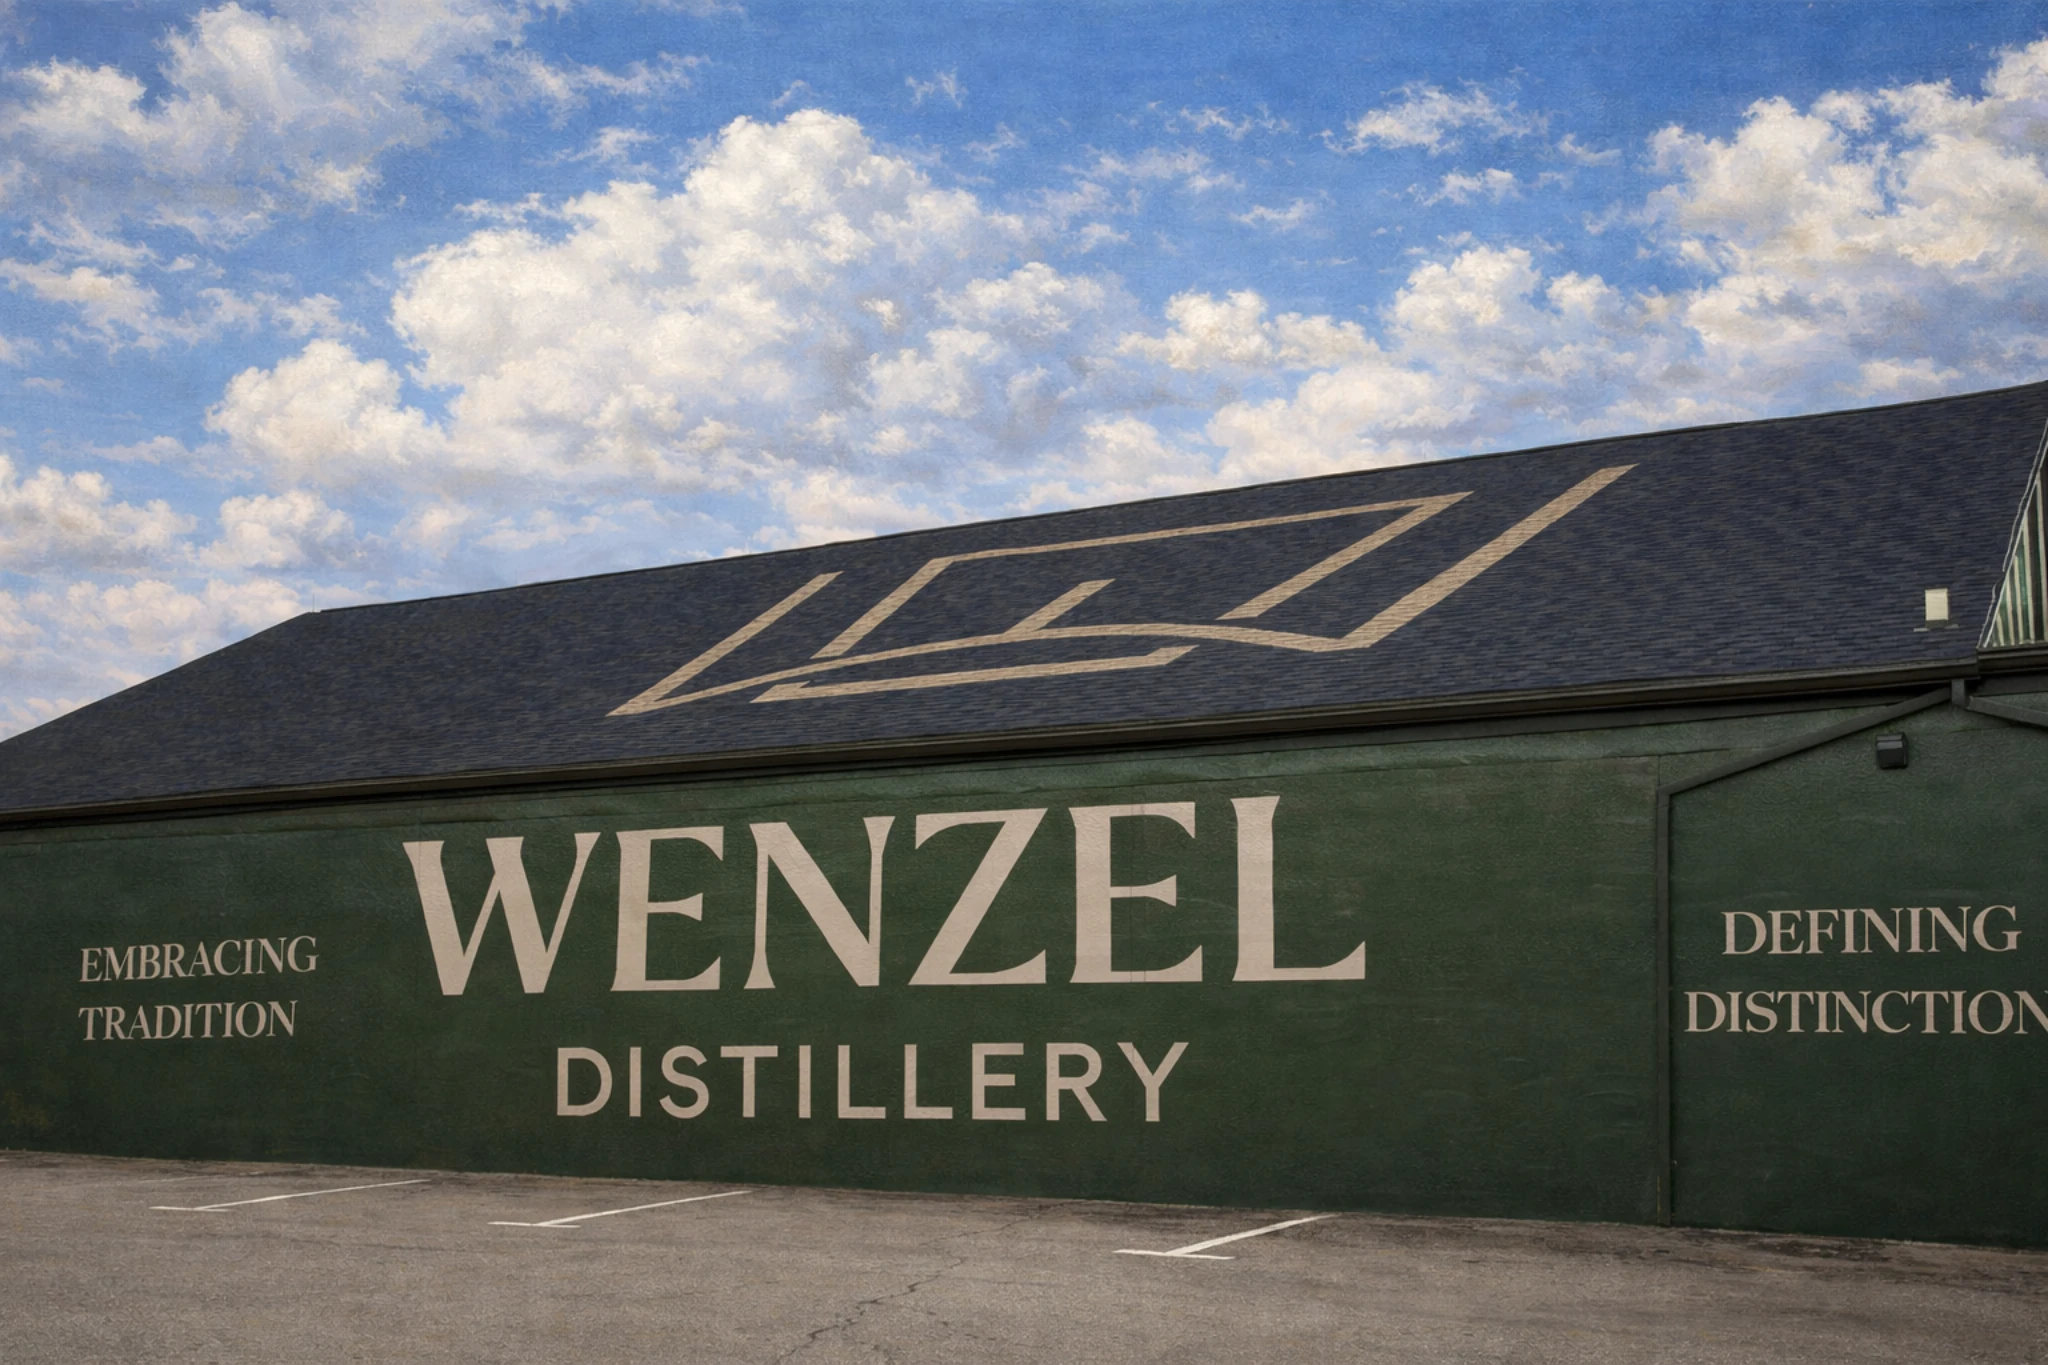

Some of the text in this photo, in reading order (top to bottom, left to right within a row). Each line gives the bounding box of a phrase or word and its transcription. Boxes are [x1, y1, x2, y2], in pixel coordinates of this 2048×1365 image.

[402, 795, 1366, 996] WENZEL
[1721, 905, 2022, 955] DEFINING
[80, 935, 319, 982] EMBRACING
[78, 1000, 298, 1040] TRADITION
[1684, 989, 2048, 1034] DISTINCTION
[556, 1041, 1189, 1122] DISTILLERY
